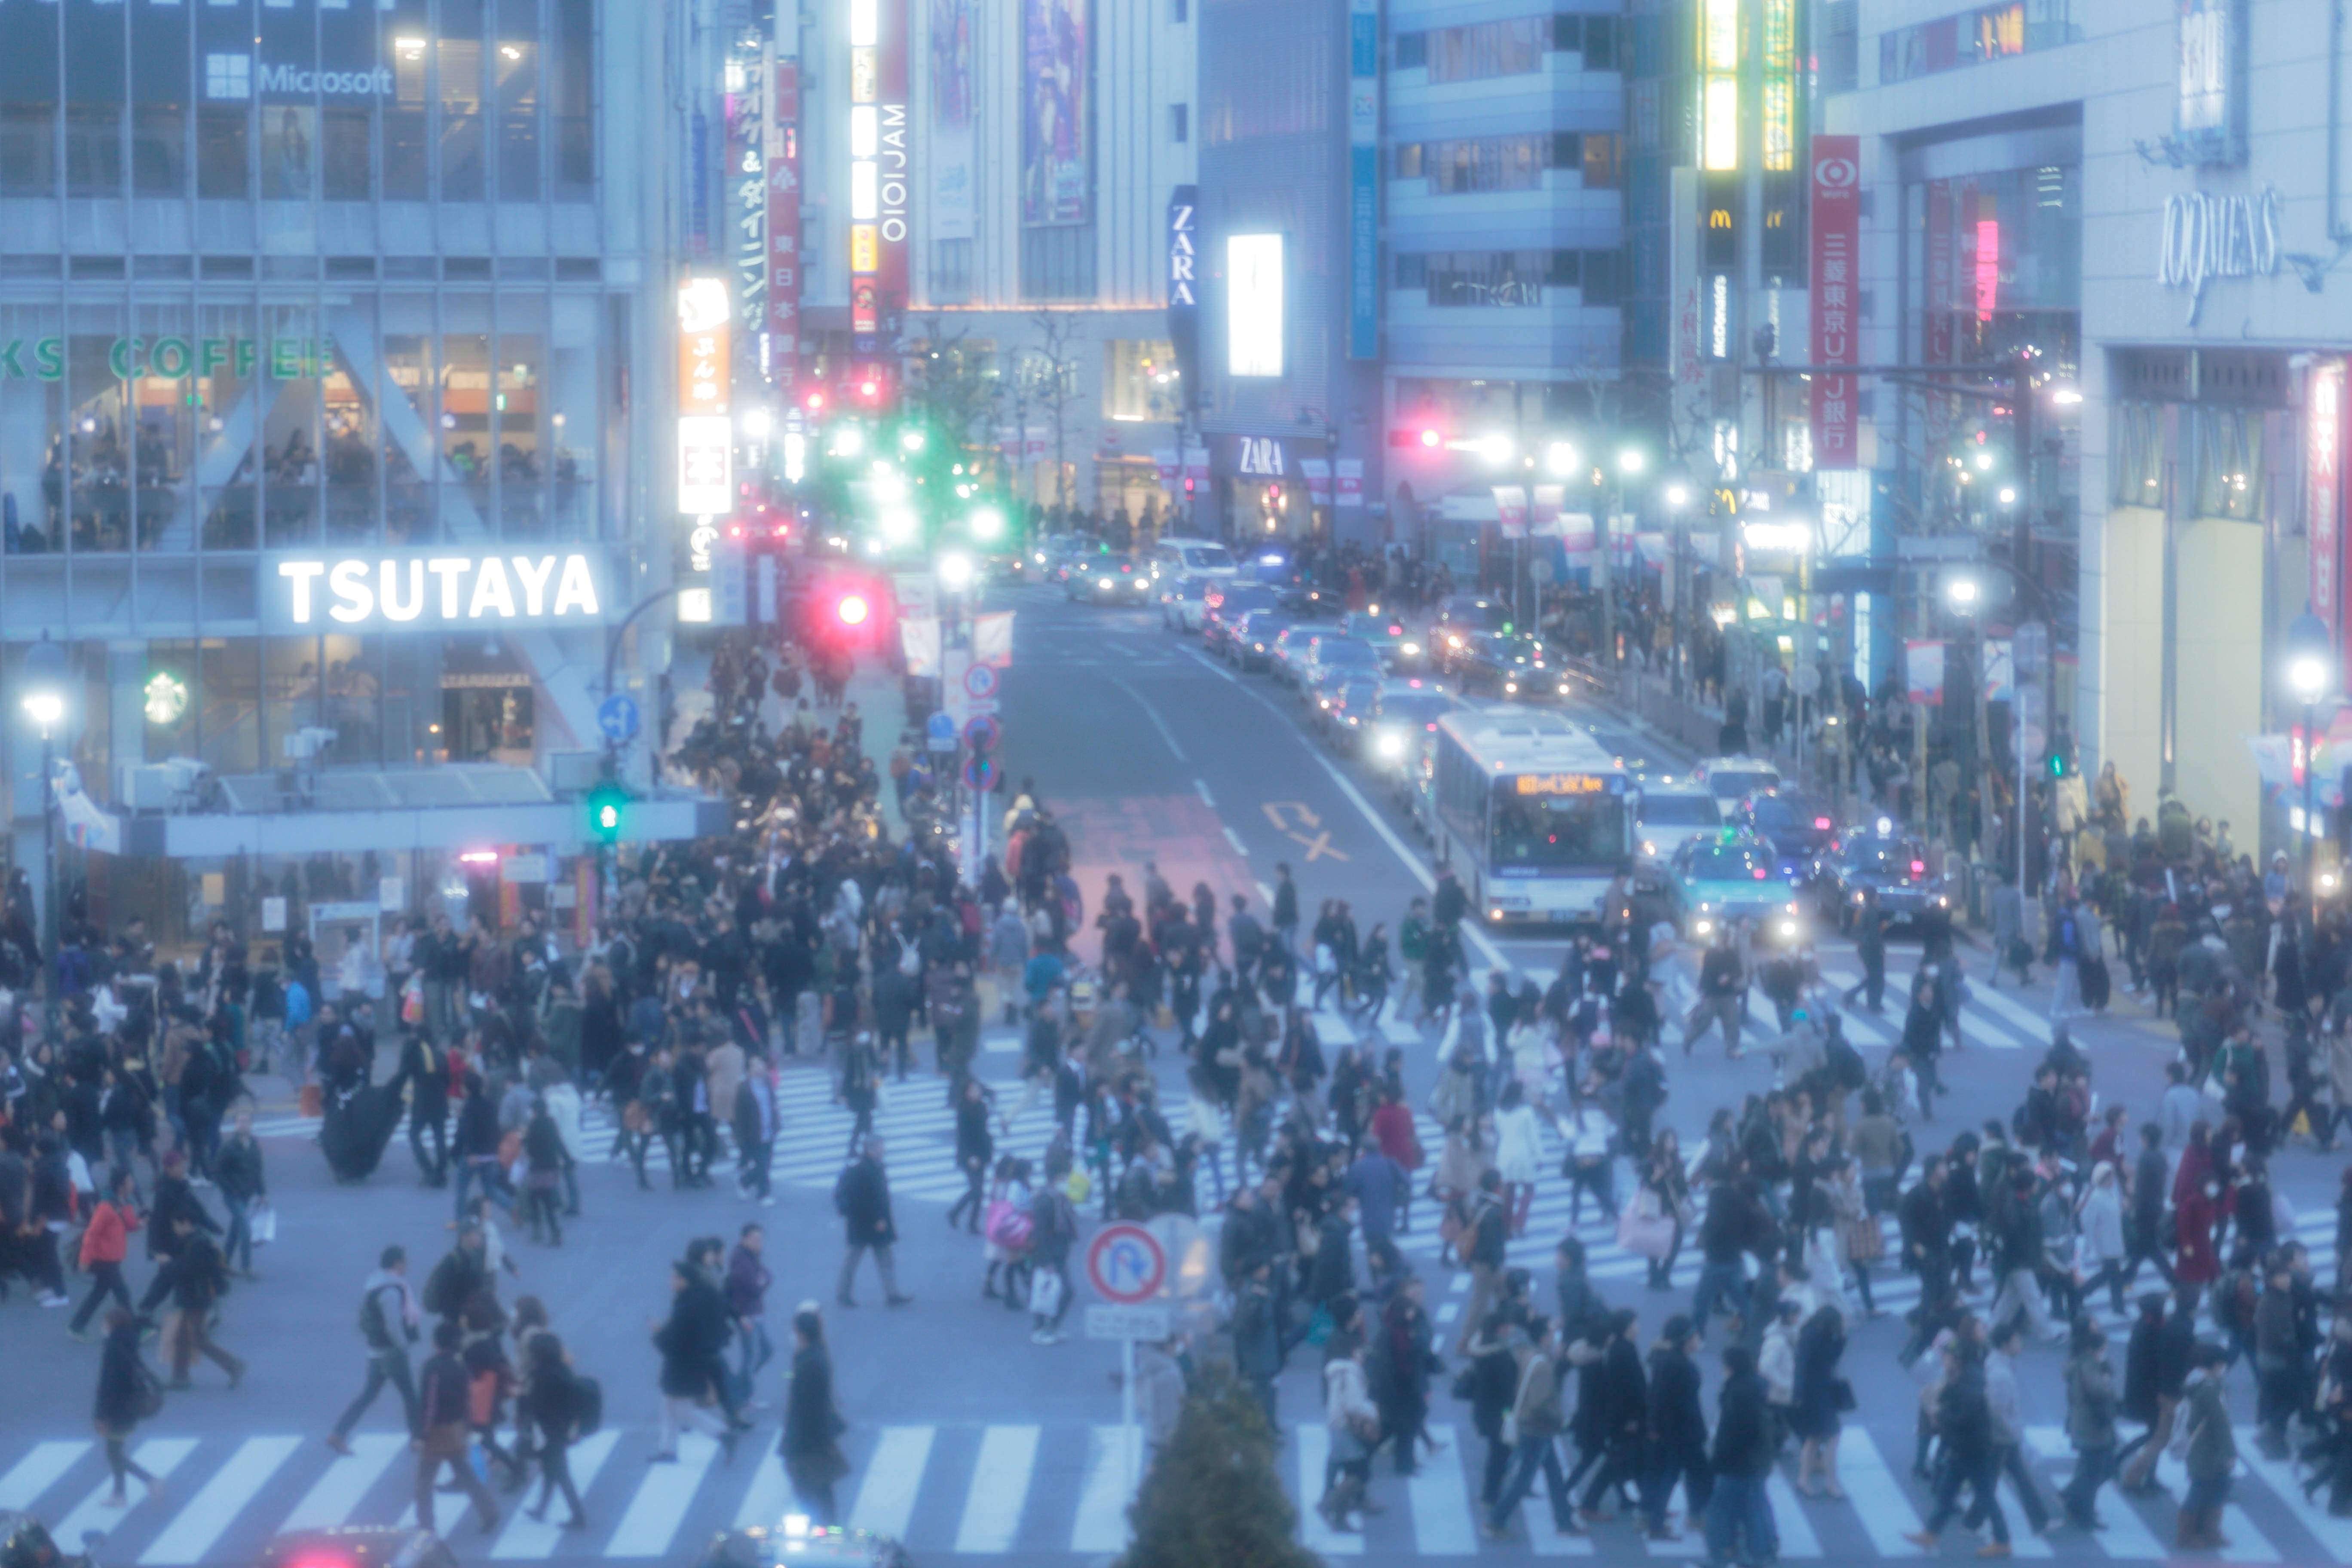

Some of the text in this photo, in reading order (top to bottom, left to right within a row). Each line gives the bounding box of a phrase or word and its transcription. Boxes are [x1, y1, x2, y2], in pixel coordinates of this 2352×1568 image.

[259, 62, 393, 94] Microsoft
[882, 104, 906, 168] JAM
[1171, 205, 1195, 305] ZARA
[774, 235, 794, 388] 東日本銀行
[108, 336, 335, 382] COFFEE
[1240, 436, 1284, 475] ZARA
[278, 554, 599, 623] TSUTAYA
